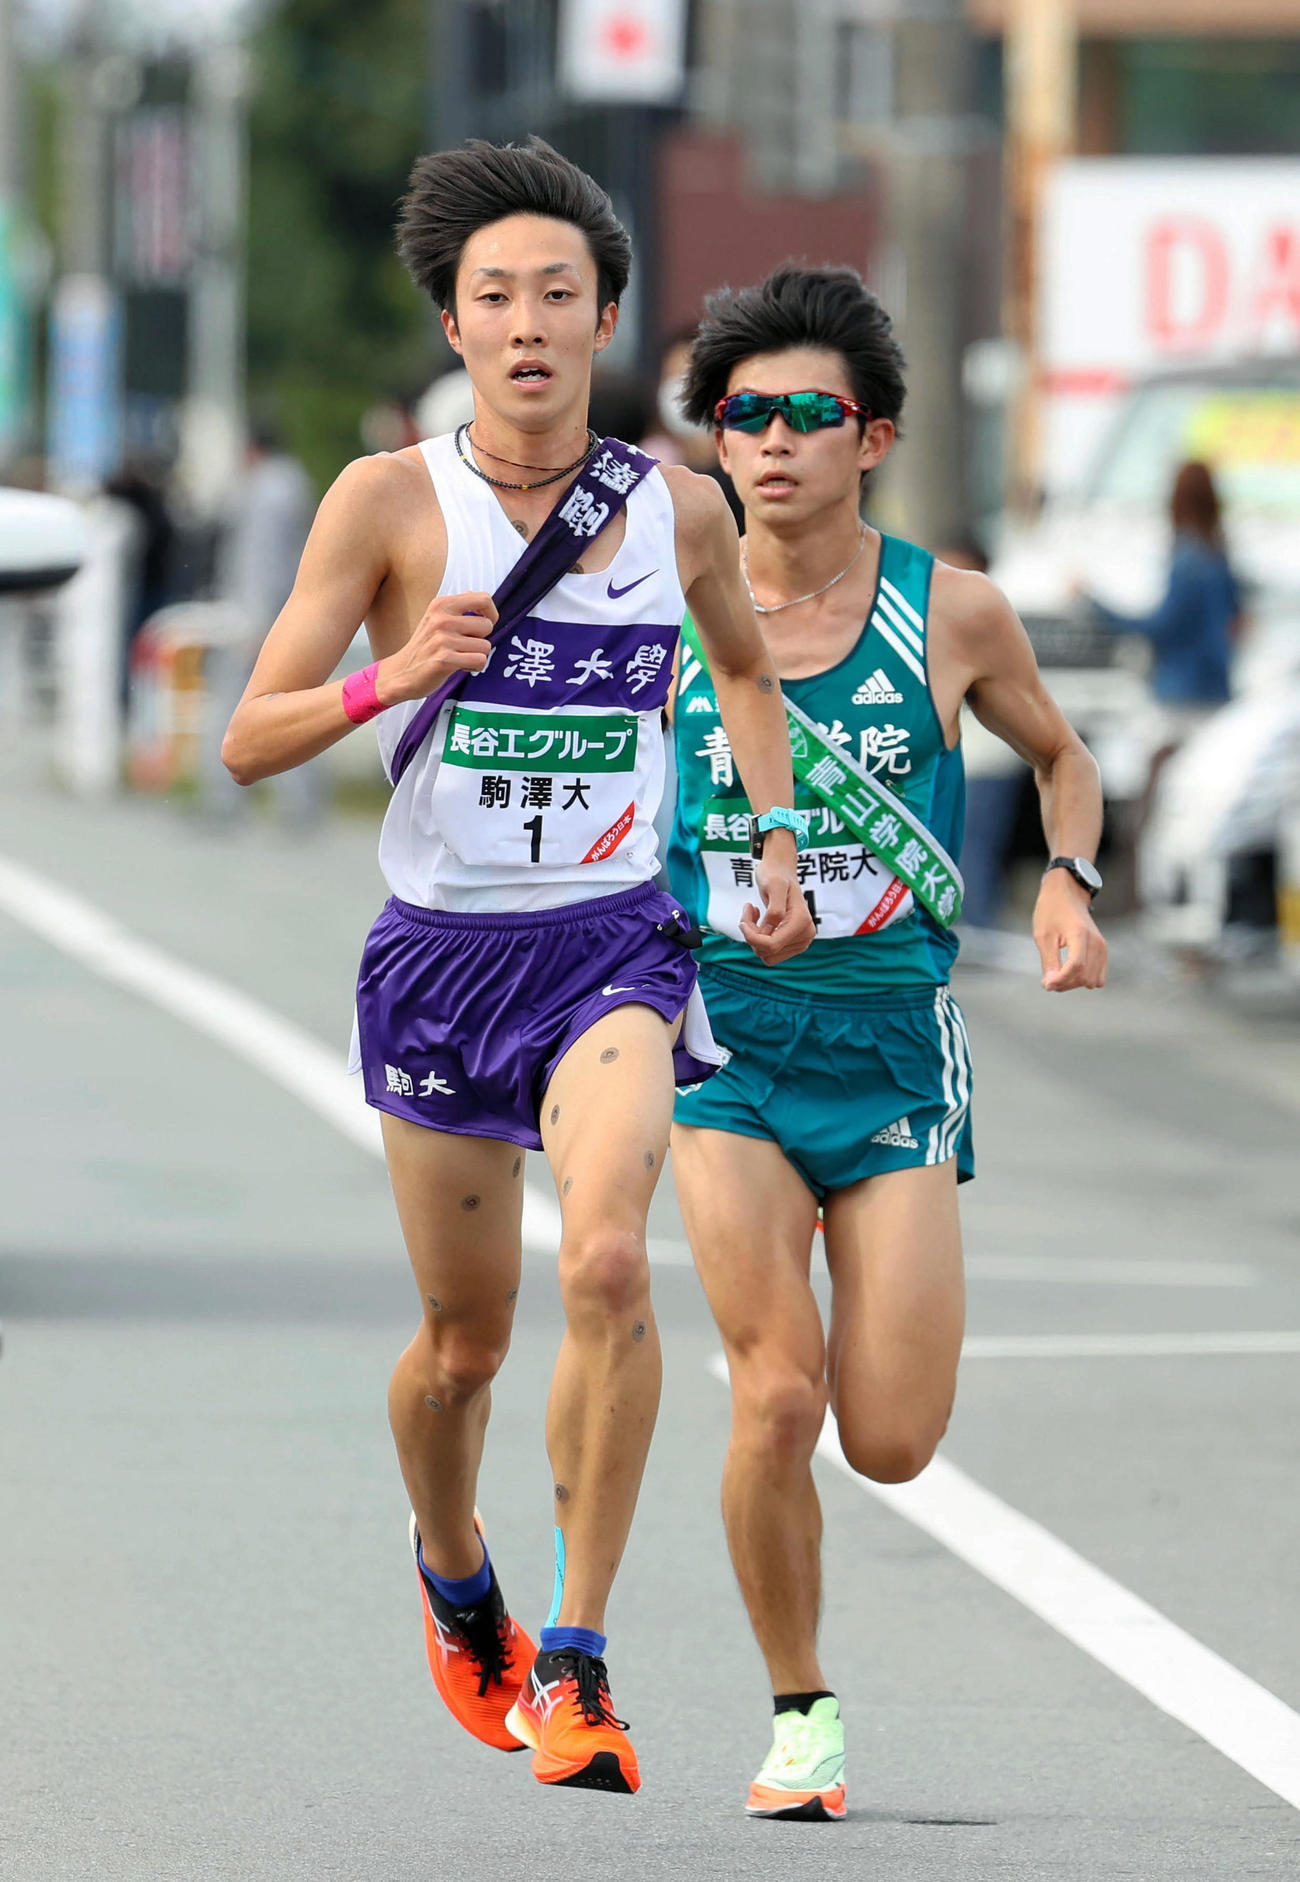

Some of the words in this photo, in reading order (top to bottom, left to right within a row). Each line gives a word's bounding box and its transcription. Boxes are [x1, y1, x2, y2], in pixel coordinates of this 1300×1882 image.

[470, 635, 668, 695] 澤大學
[852, 690, 904, 706] adidas
[450, 722, 633, 761] 長谷工グループ
[694, 719, 912, 788] 青学院
[478, 775, 592, 811] 駒澤大
[523, 814, 544, 863] 1
[591, 814, 633, 862] がんばろう日本
[805, 754, 957, 920] 青山学院大学
[729, 848, 879, 888] 青学院大
[384, 1063, 457, 1097] 駒大
[871, 1132, 919, 1149] adidas
